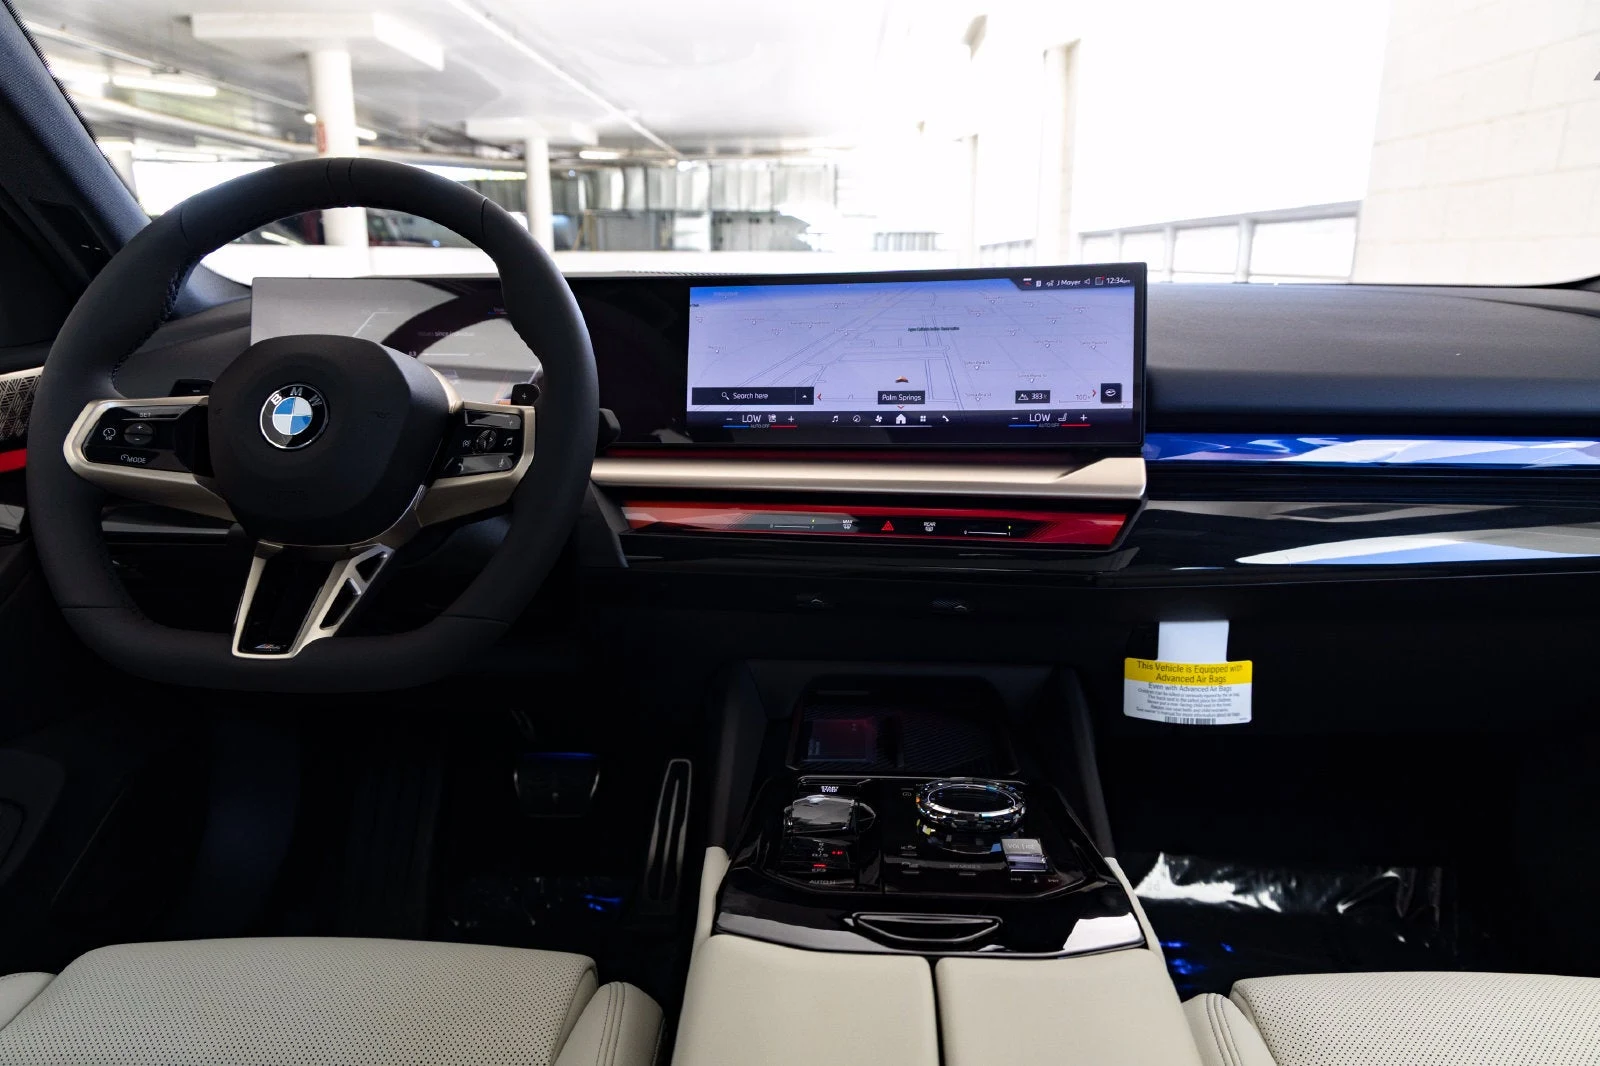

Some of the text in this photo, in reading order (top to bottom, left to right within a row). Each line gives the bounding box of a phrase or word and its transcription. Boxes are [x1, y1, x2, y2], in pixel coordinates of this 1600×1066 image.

[270, 386, 324, 408] BMW
[732, 392, 769, 400] Search here
[882, 393, 922, 402] Palm Springs
[741, 413, 762, 423] LOW
[1029, 413, 1051, 422] LOW
[127, 456, 147, 464] MODE
[1136, 660, 1154, 670] This
[1155, 662, 1184, 673] Vehicle
[1185, 665, 1192, 673] is
[1194, 665, 1229, 674] Equipped
[1156, 673, 1227, 685] Advanced Air Bags
[1148, 682, 1164, 690] Even
